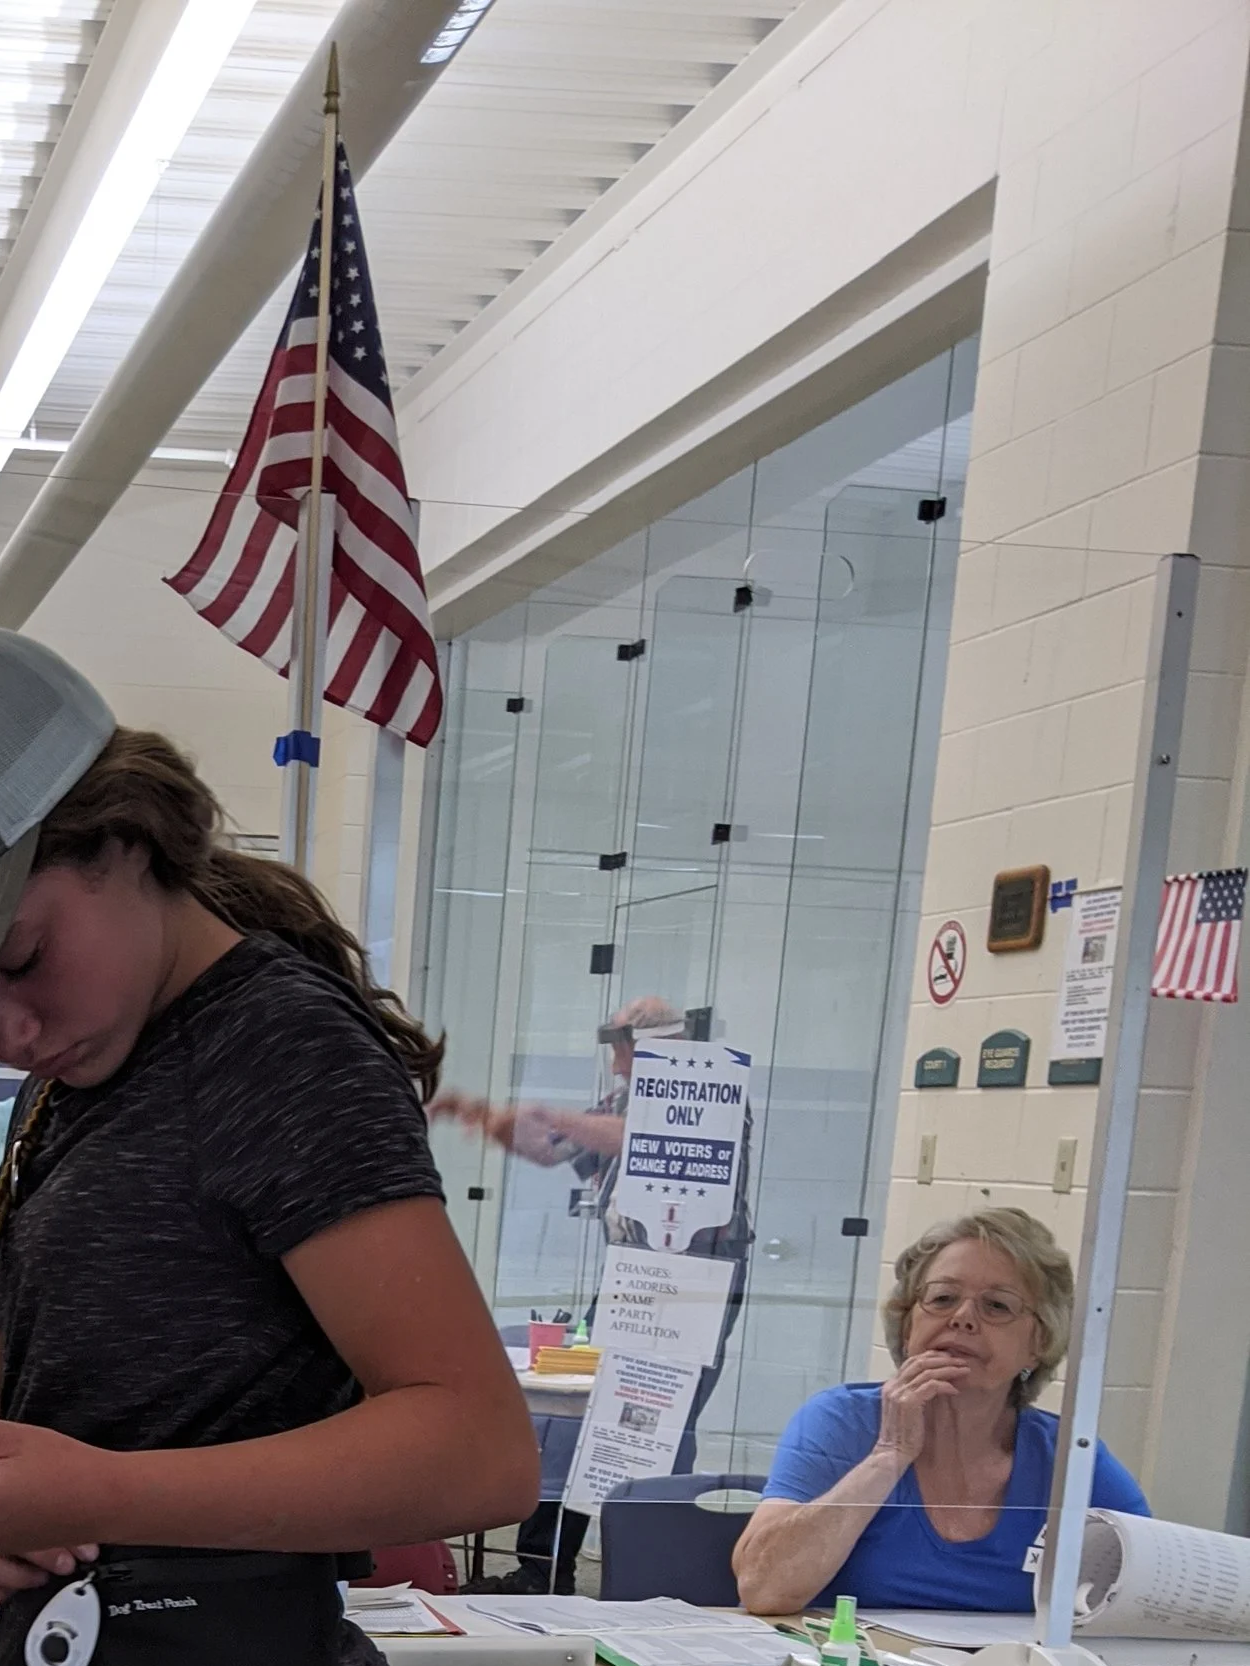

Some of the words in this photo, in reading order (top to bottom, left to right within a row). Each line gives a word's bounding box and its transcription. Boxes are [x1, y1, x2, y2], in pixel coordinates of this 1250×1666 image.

[635, 1077, 742, 1105] REGISTRATION
[666, 1105, 704, 1127] ONLY
[631, 1138, 661, 1155] NEW
[665, 1140, 713, 1160] VOTERS
[718, 1149, 732, 1161] or
[629, 1159, 666, 1174] CHANGE
[669, 1162, 682, 1175] OF
[685, 1163, 730, 1180] ADDRESS
[616, 1262, 672, 1279] CHANGES:
[626, 1280, 679, 1295] ADDRESS
[621, 1293, 655, 1306] NAME
[618, 1307, 656, 1321] PARTY
[610, 1321, 681, 1340] AFFILIATION
[108, 1603, 131, 1617] Dog
[133, 1599, 164, 1611] Treat
[163, 1596, 198, 1609] Pouch
